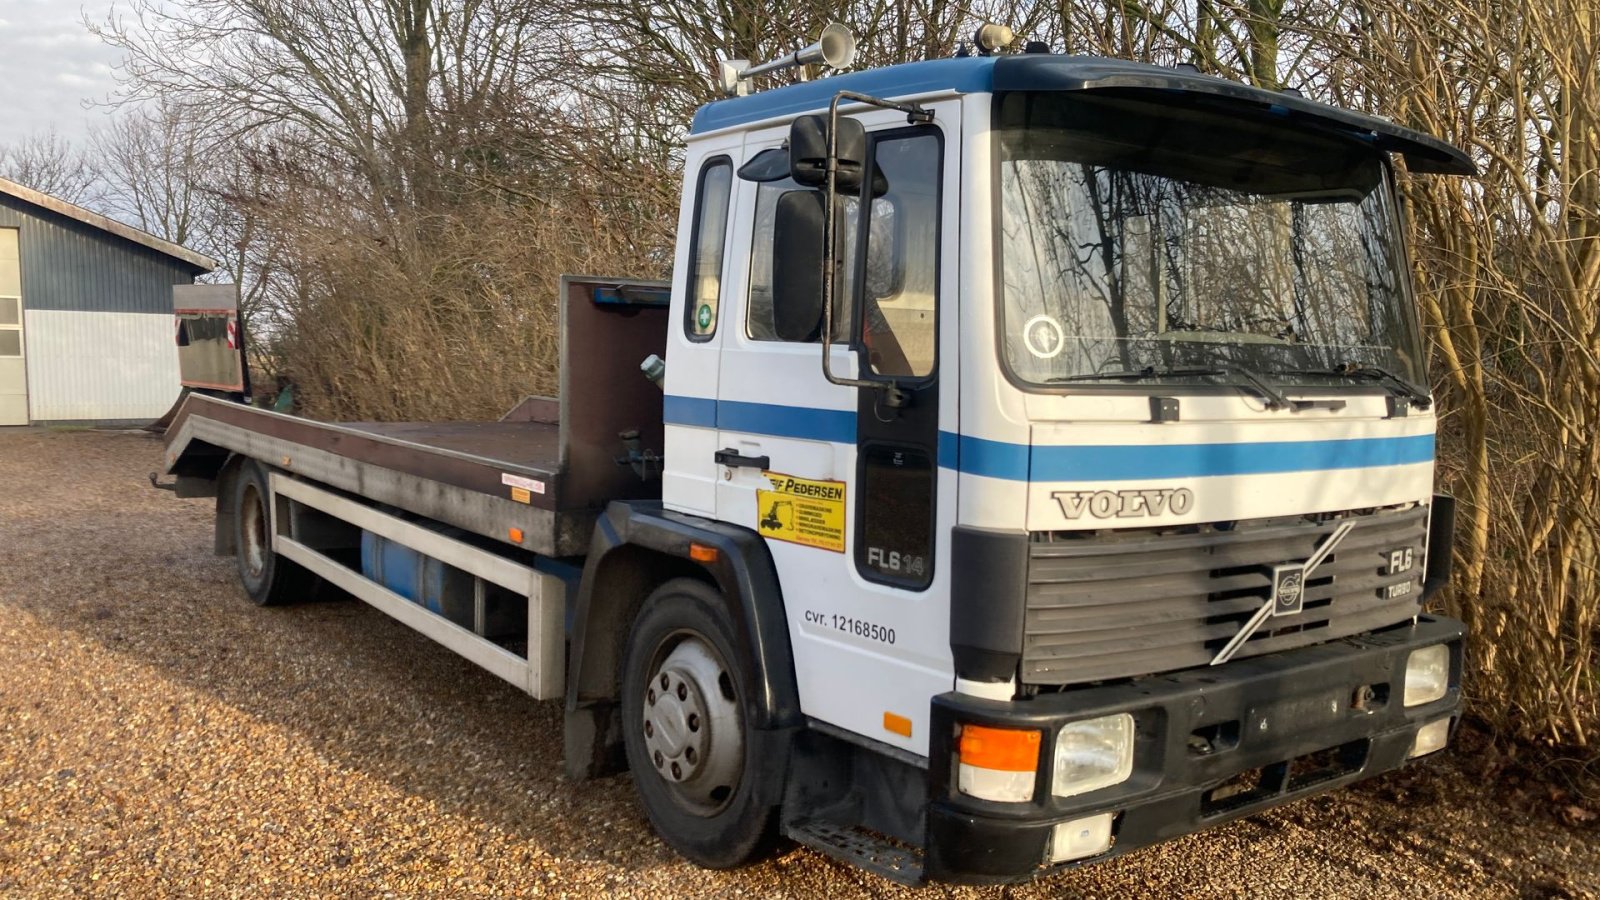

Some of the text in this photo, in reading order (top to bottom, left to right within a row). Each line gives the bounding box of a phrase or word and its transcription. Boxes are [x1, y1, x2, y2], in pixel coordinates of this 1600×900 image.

[785, 479, 843, 500] PEDERSEN
[1051, 487, 1194, 520] VOLVO
[868, 547, 924, 575] FL6 14
[1390, 548, 1413, 575] FL6
[805, 610, 896, 644] cvr. 12168500
